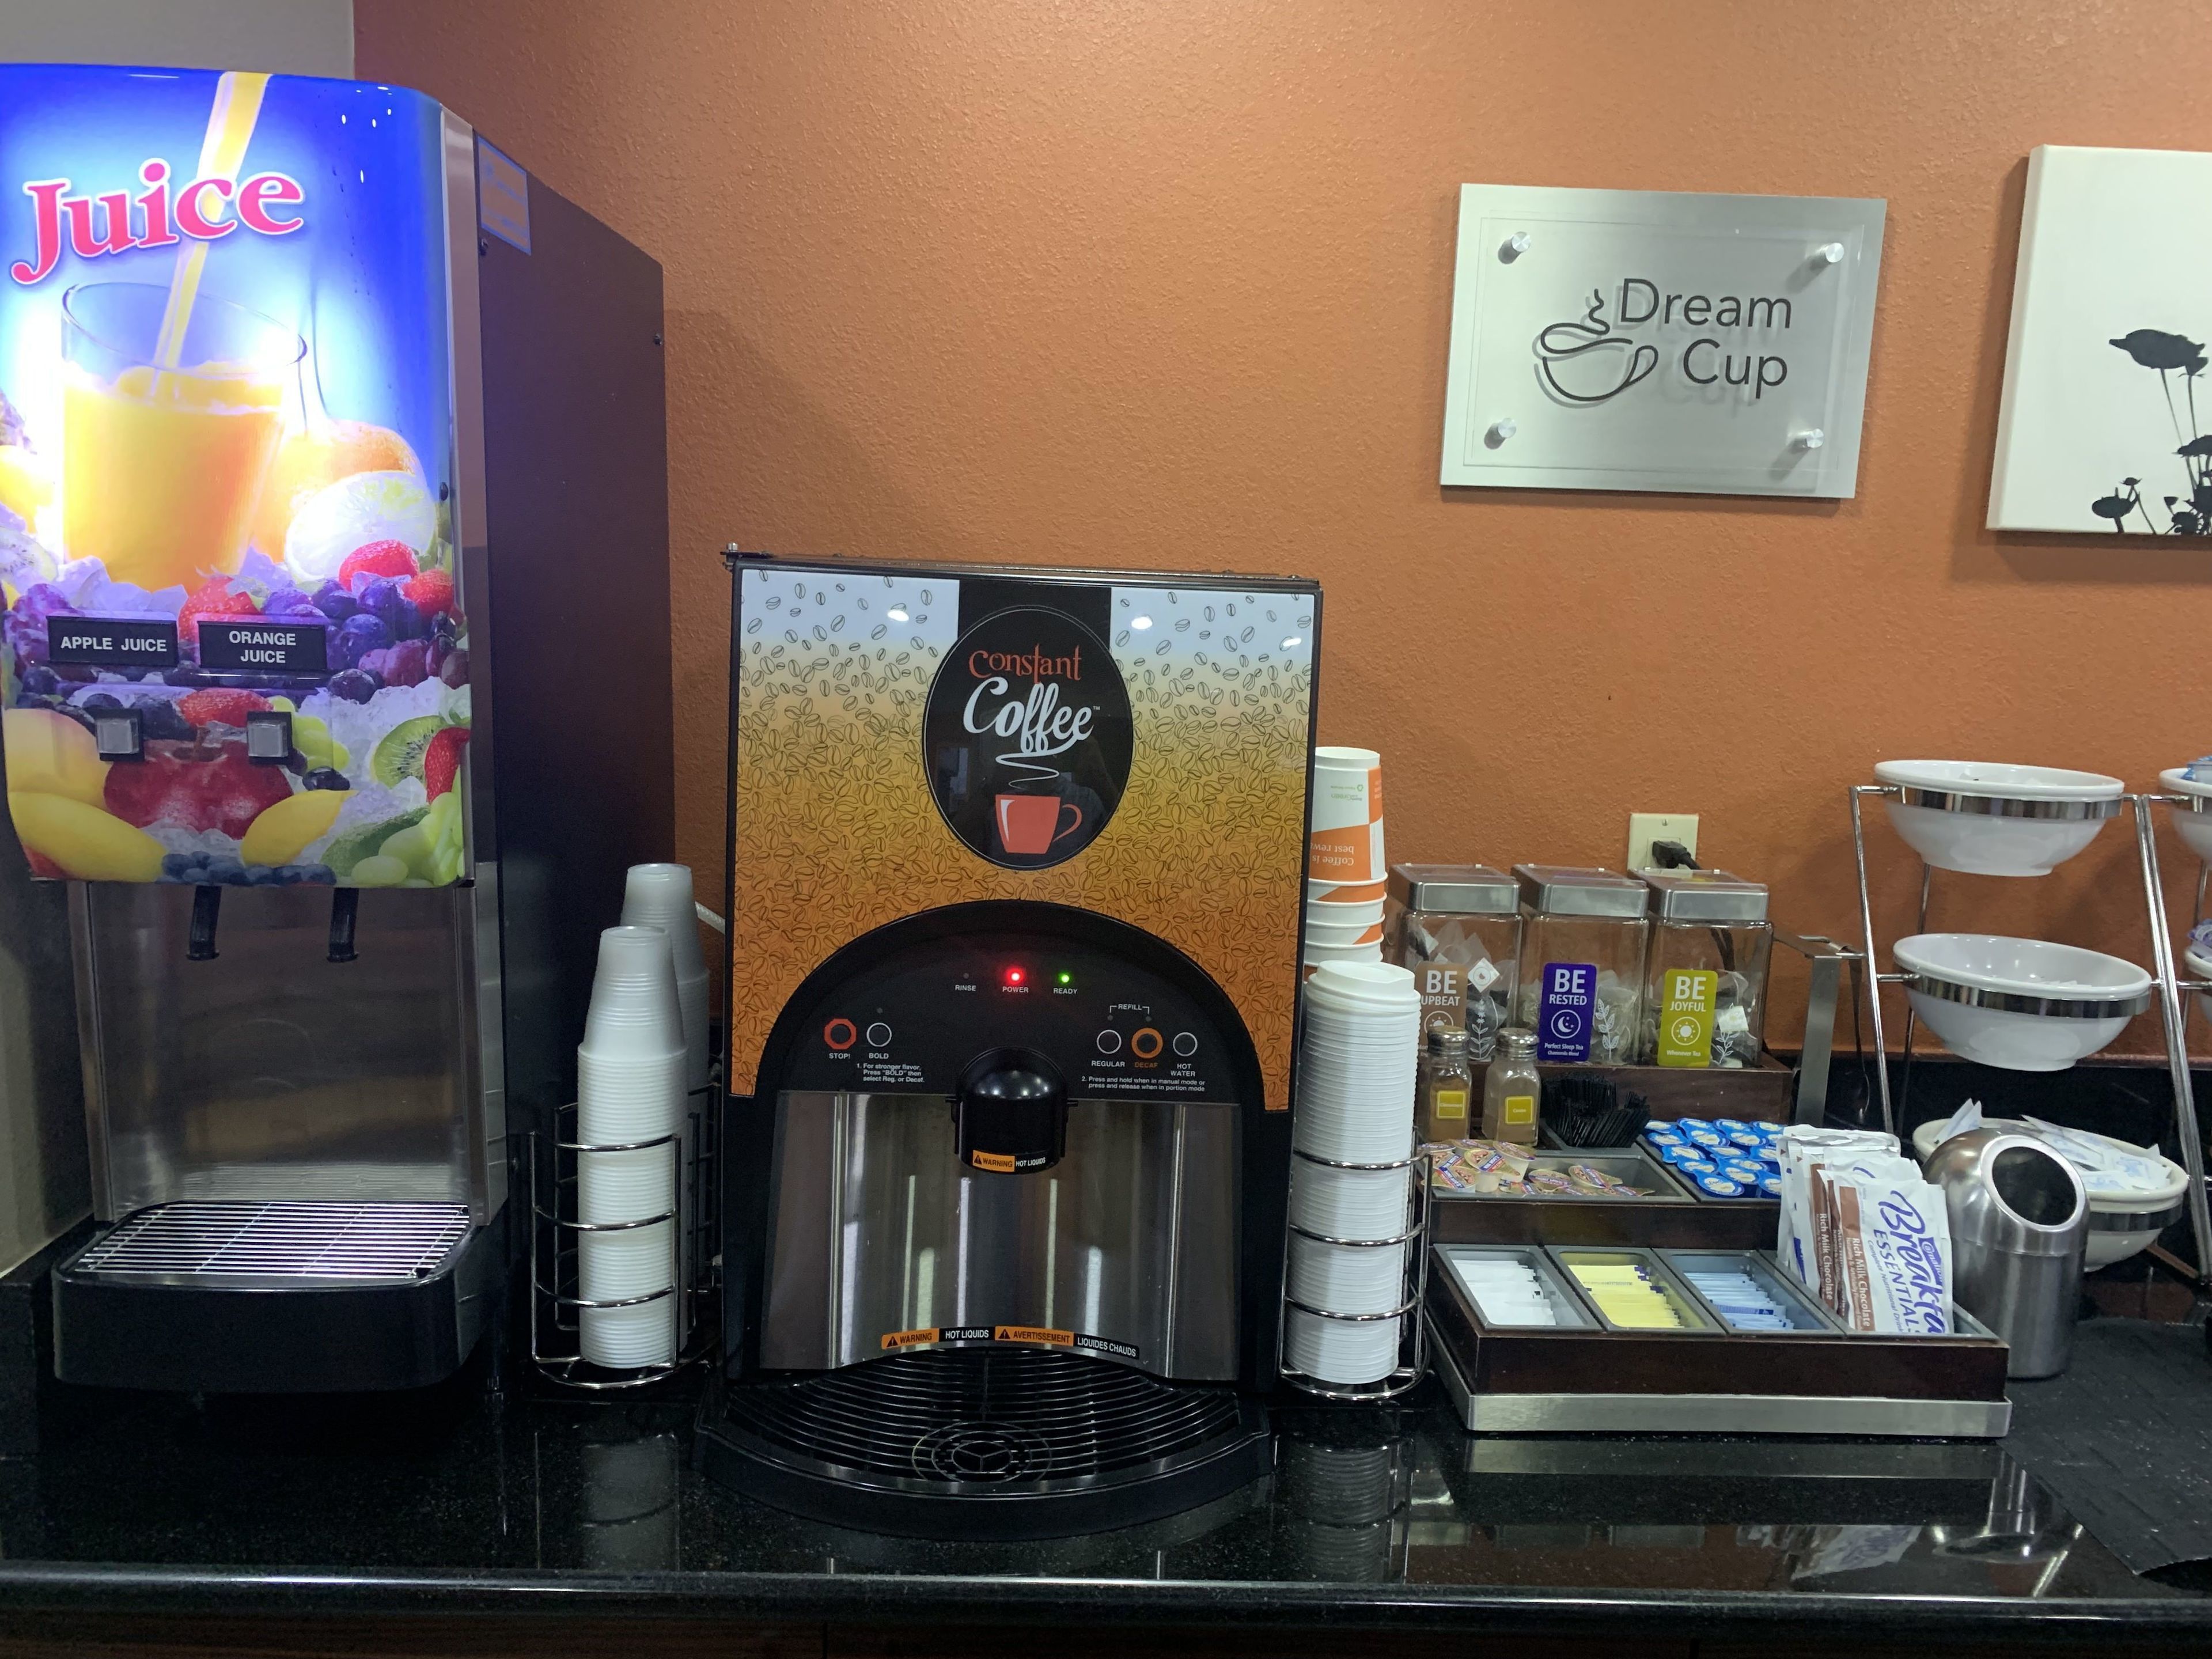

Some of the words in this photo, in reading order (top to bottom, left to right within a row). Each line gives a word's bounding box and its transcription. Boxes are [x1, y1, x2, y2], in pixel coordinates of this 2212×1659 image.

[12, 158, 305, 284] Juice
[1620, 278, 1791, 328] Dream
[1683, 339, 1787, 399] Cup
[60, 637, 112, 650] APPLE
[121, 638, 167, 652] JUICE
[229, 631, 296, 646] ORANGE
[240, 650, 286, 663] JUICE
[968, 643, 1082, 684] Constant
[963, 677, 1094, 753] Coffee
[1312, 855, 1320, 863] is
[1335, 844, 1354, 855] best
[1323, 856, 1354, 866] Coffee
[1426, 970, 1457, 994] BE
[1554, 969, 1586, 993] BE
[1675, 976, 1706, 1000] BE
[1421, 995, 1460, 1006] UPBEAT
[1549, 994, 1587, 1006] RESTED
[1670, 1001, 1706, 1012] JOYFUL
[983, 1158, 1013, 1168] WARNING
[1028, 1157, 1046, 1166] LIQUIDS
[1820, 1213, 1828, 1232] Rich
[1821, 1233, 1830, 1253] Milk
[1853, 1238, 1862, 1256] Rich
[1823, 1255, 1833, 1300] Chocolate
[1855, 1259, 1866, 1279] Milk
[1868, 1240, 1884, 1272] Complete
[1880, 1272, 1897, 1311] Nutritional
[1858, 1281, 1871, 1327] Chocolate
[900, 1332, 932, 1343] WARNING
[945, 1331, 960, 1339] HOT
[961, 1330, 989, 1339] LIQUIDS
[1013, 1330, 1070, 1344] AVERTISSEMENT
[1077, 1336, 1108, 1351] LIQUIDES
[1109, 1341, 1137, 1357] CHAUDS
